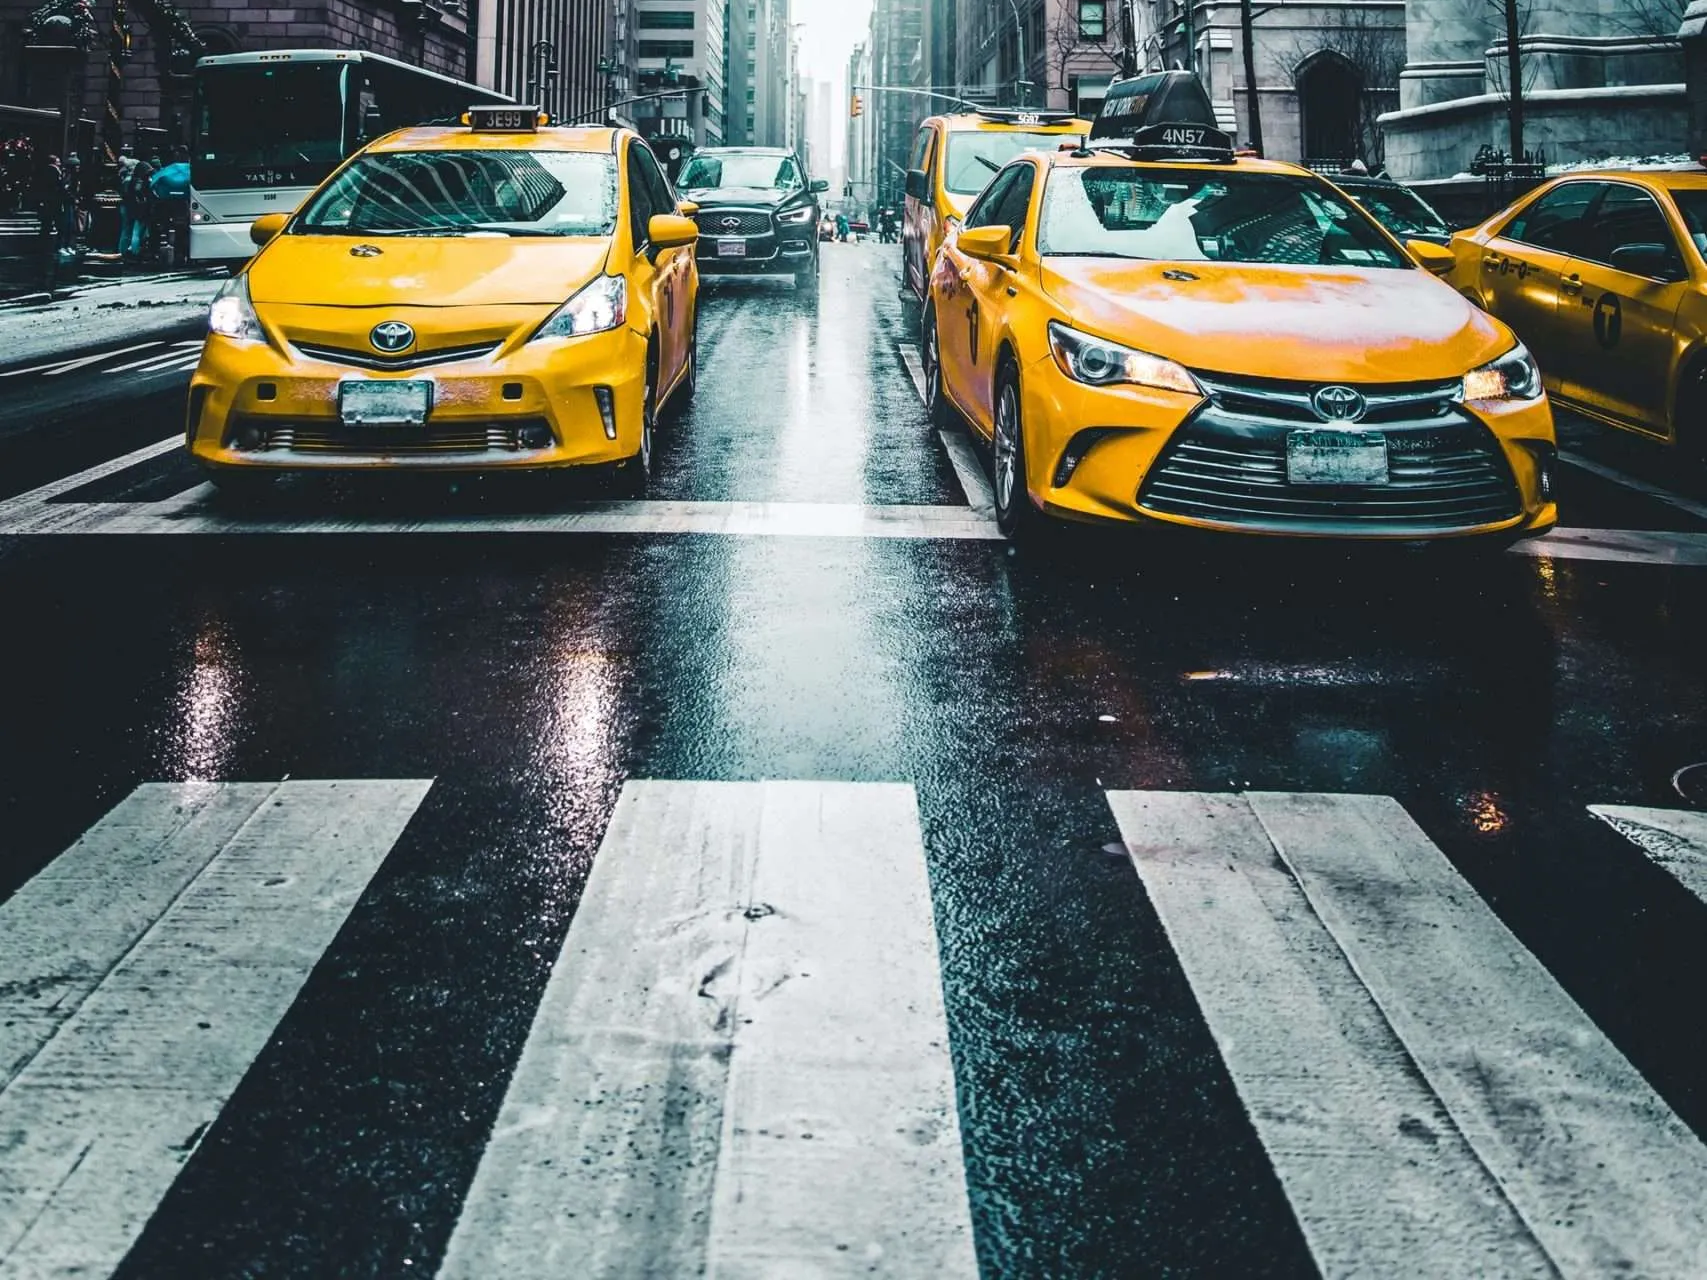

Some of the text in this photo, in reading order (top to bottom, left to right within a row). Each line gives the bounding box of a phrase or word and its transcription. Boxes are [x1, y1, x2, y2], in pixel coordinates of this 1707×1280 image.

[486, 111, 522, 127] 3E99
[1161, 128, 1206, 144] 4N57
[1600, 303, 1616, 342] T
